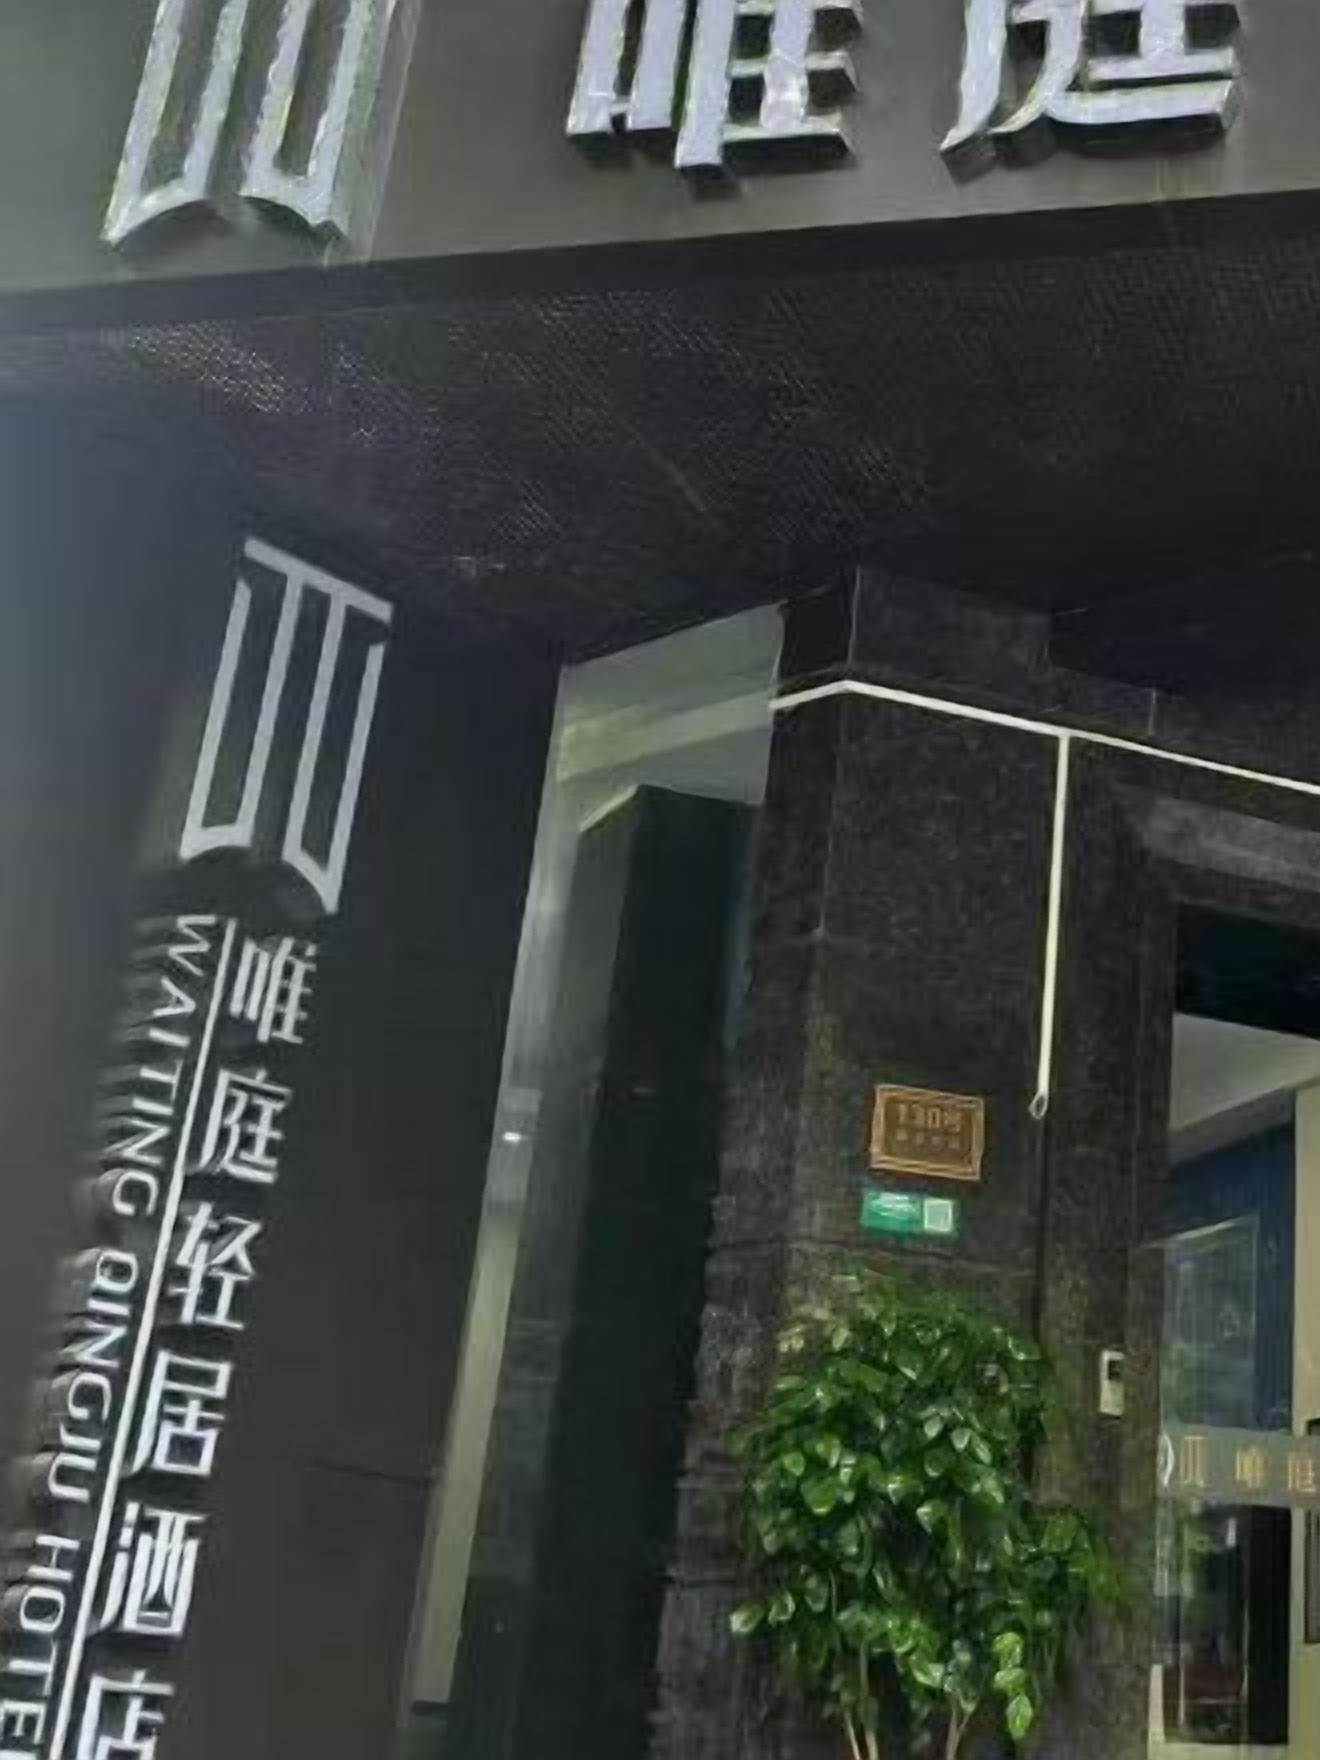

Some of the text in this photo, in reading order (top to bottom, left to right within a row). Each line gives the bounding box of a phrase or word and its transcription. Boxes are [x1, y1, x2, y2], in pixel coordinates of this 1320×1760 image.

[0, 914, 217, 1760] WAITING QINGJU HOTE
[76, 935, 319, 1760] 唯庭轻居酒店
